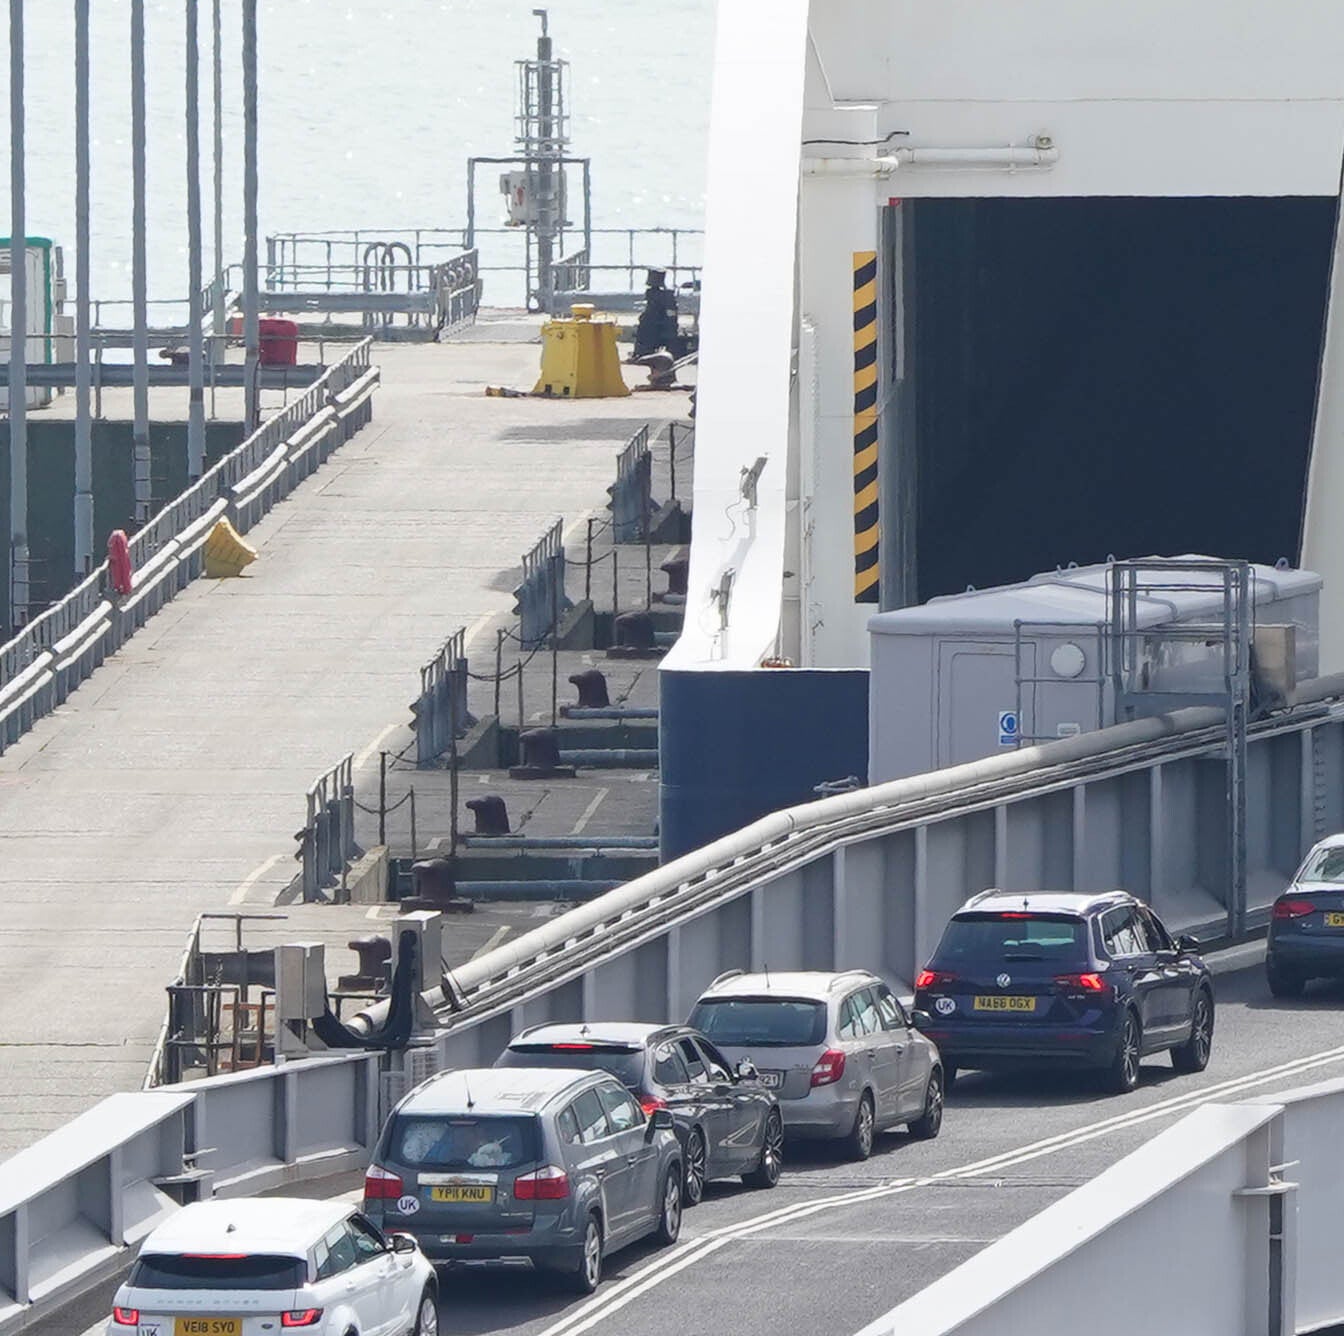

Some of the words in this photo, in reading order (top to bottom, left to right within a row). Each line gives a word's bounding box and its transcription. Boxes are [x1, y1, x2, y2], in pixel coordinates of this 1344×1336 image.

[938, 1000, 953, 1012] UK
[462, 1186, 485, 1199] KNU
[400, 1198, 419, 1211] UK
[182, 1320, 209, 1334] VE18
